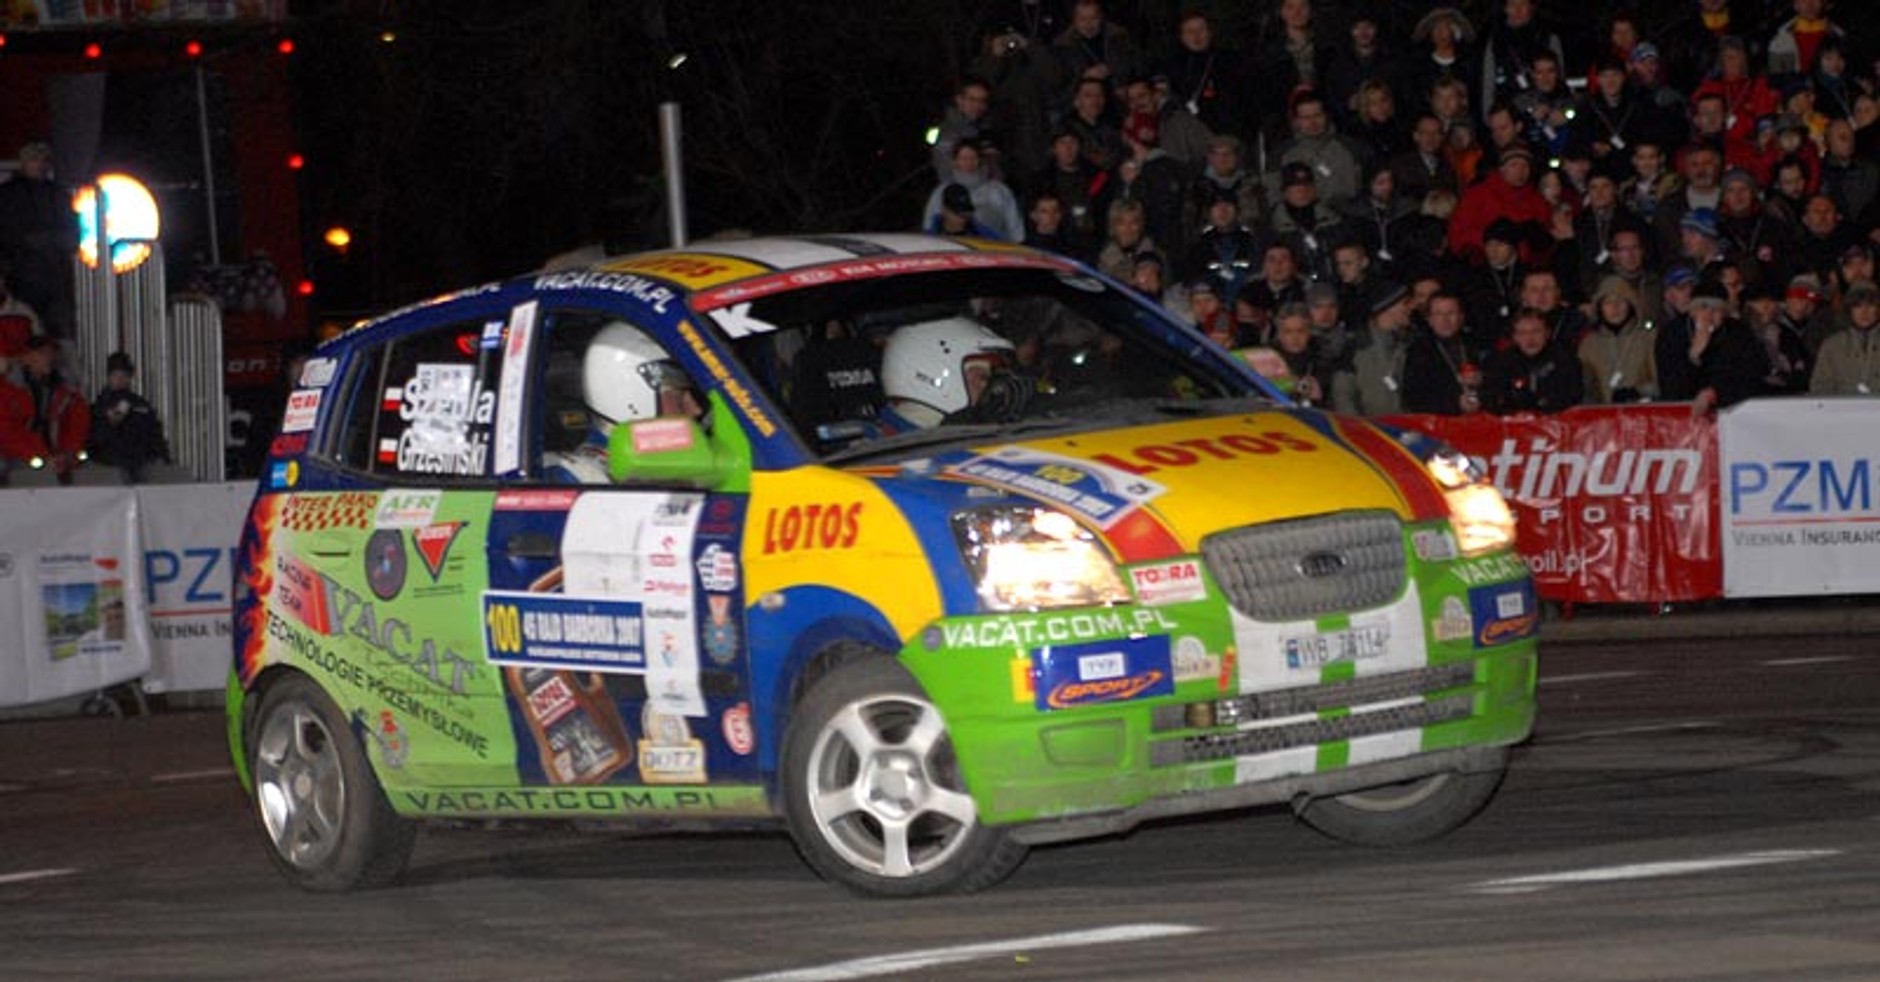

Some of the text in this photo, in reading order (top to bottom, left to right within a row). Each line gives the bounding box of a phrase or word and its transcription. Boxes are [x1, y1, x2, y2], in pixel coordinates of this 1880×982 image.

[533, 271, 676, 314] VACAT.COM.PL
[1092, 431, 1317, 474] LOTOS
[1473, 438, 1702, 500] tinum
[1730, 459, 1870, 514] PZM
[763, 501, 862, 554] LOTOS
[145, 547, 236, 603] PZ
[266, 608, 363, 688] TECHNOLOGIE
[319, 571, 478, 696] VACAT
[488, 603, 522, 653] 100
[942, 610, 1179, 648] VACAT.COM.PL
